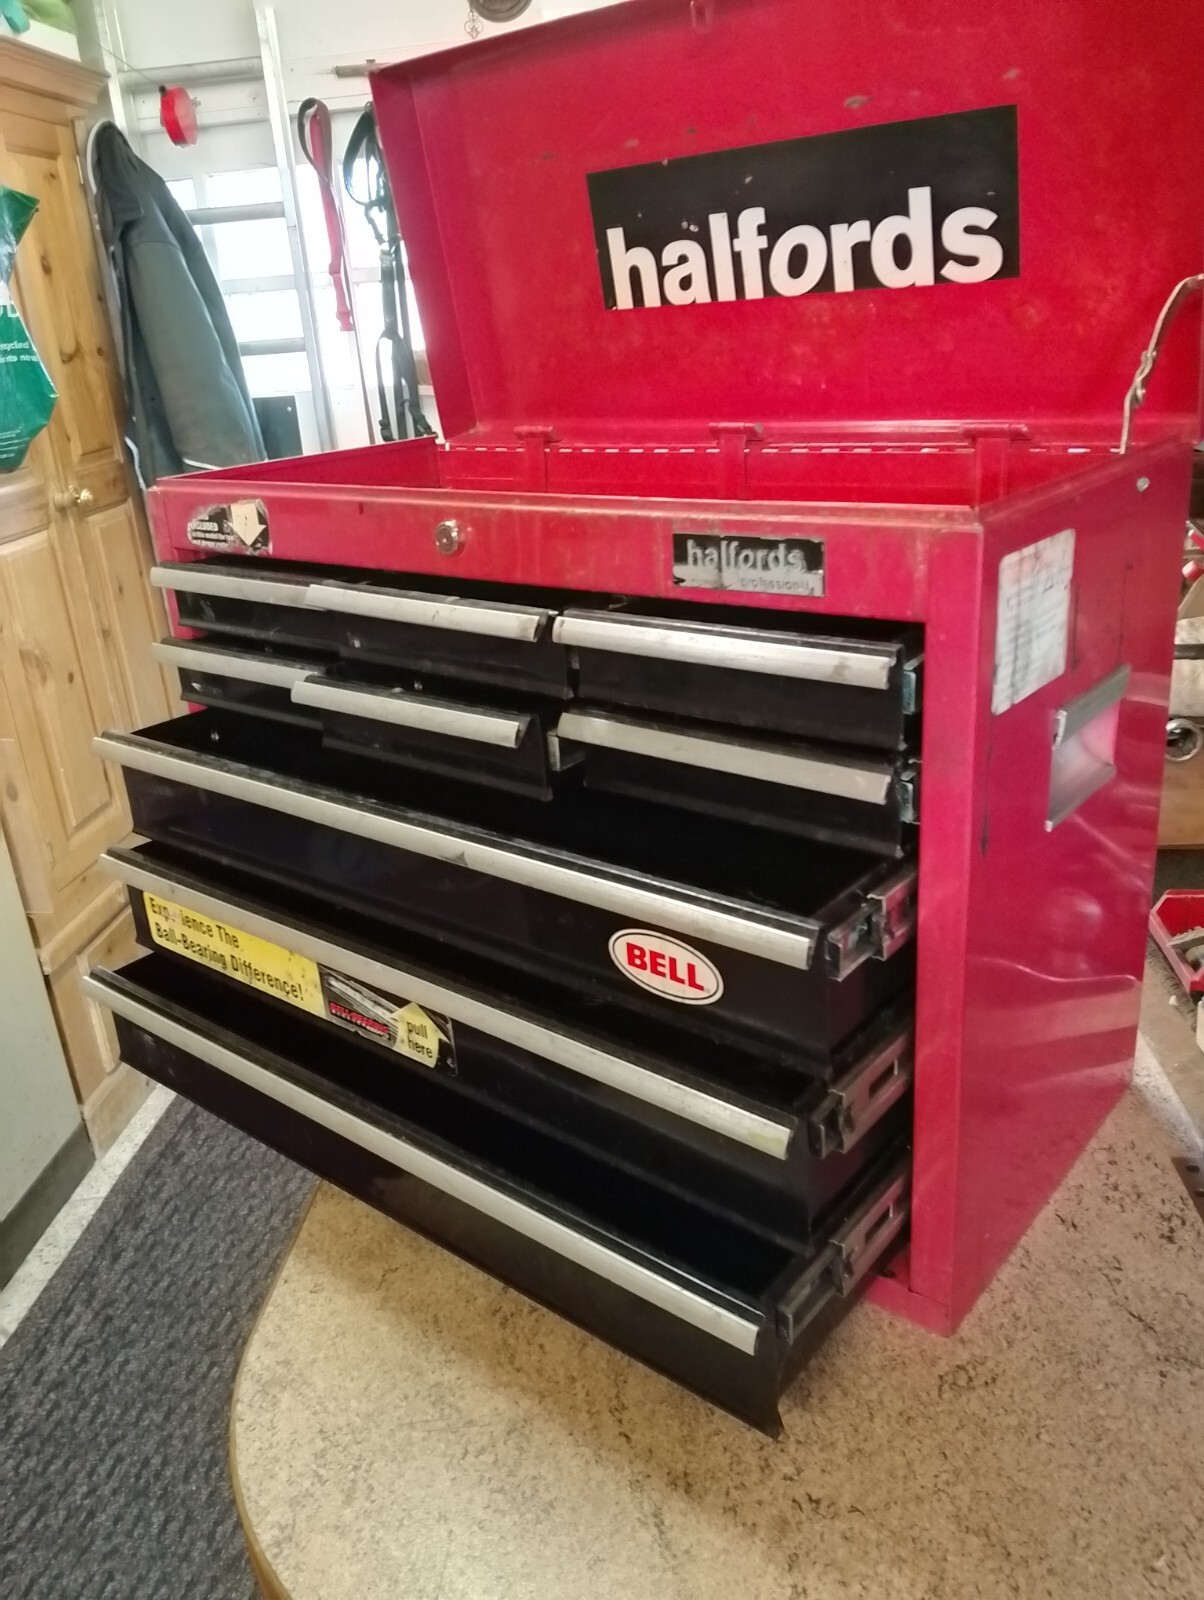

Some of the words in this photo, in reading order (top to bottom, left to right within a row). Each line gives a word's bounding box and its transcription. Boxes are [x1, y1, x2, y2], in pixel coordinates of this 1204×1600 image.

[606, 186, 1004, 311] halfords
[687, 538, 806, 573] halfords
[215, 925, 240, 949] The
[155, 921, 227, 972] Ball-Bearing
[230, 954, 305, 1002] Difference!
[626, 941, 705, 992] BELL
[407, 1021, 428, 1040] pull
[408, 1037, 434, 1059] here
